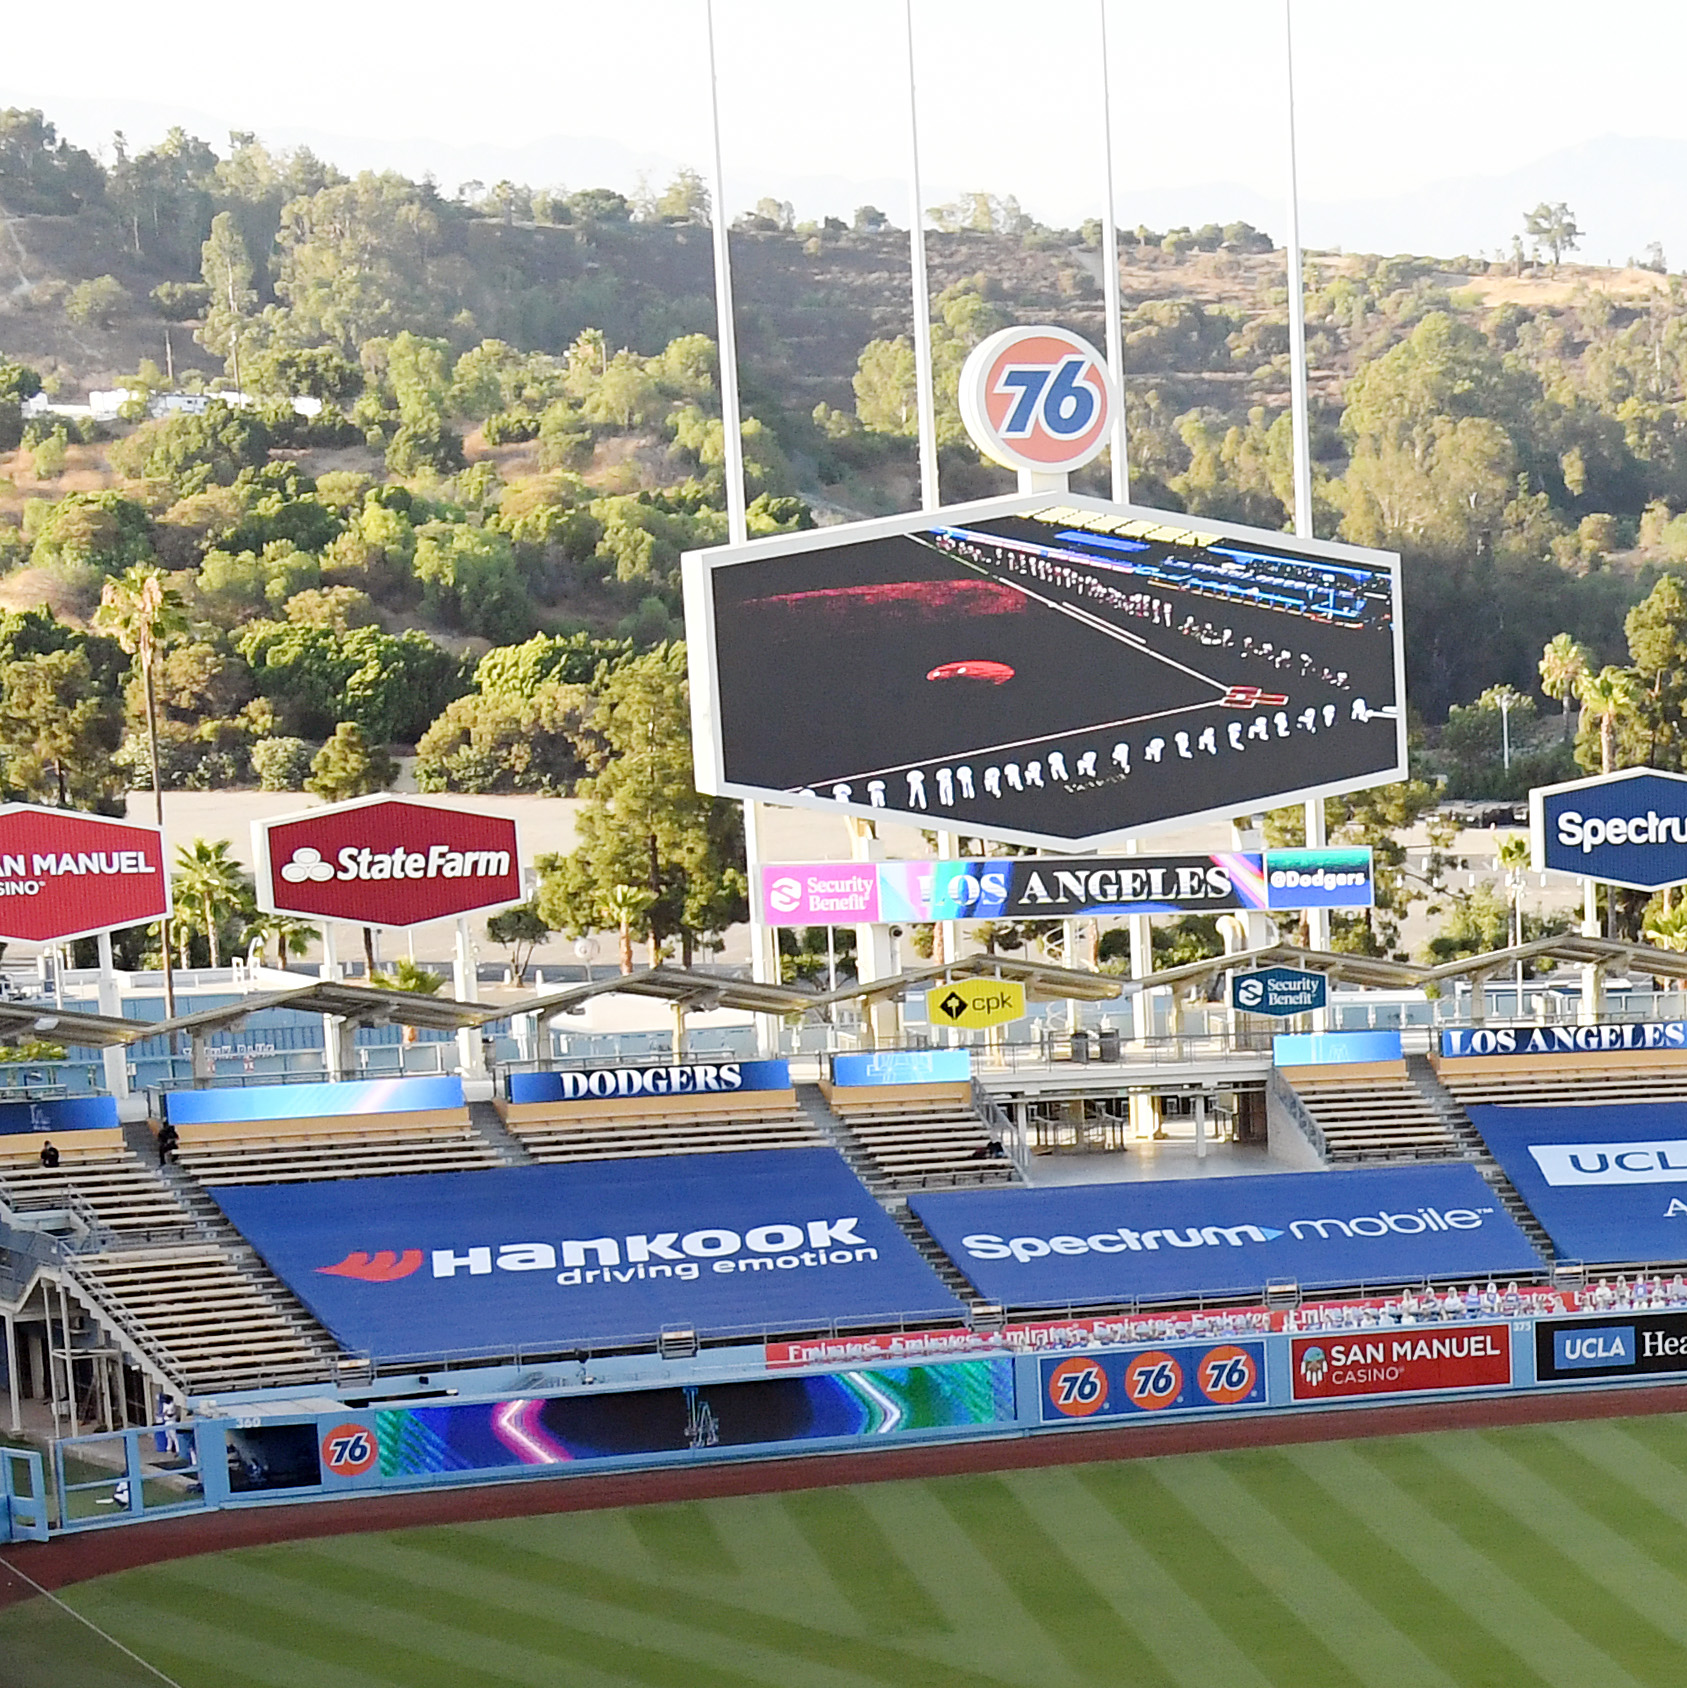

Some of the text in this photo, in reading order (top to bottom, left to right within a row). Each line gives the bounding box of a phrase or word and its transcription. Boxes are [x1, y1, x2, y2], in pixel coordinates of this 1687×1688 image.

[997, 357, 1098, 437] 76
[32, 851, 156, 876] MANUEL
[1270, 868, 1366, 891] @Dodgers
[807, 875, 873, 899] Security
[809, 892, 869, 912] Benefit
[917, 866, 1231, 908] LOS ANGELES
[971, 992, 1013, 1014] cpk
[1267, 978, 1319, 998] Security
[1268, 992, 1315, 1006] Benefit
[1450, 1022, 1687, 1057] LOS ANGELES
[560, 1063, 743, 1099] DODGERS
[961, 1220, 1264, 1264] Spectrum
[556, 1245, 879, 1287] driving emotion
[1331, 1333, 1501, 1366] SAN MANUEL
[1564, 1335, 1626, 1360] UCLA
[1057, 1369, 1100, 1402] 76
[1133, 1362, 1177, 1396] 76
[1207, 1356, 1249, 1390] 76
[1332, 1366, 1402, 1386] CASINO
[236, 1417, 262, 1428] 360
[329, 1433, 371, 1466] 76
